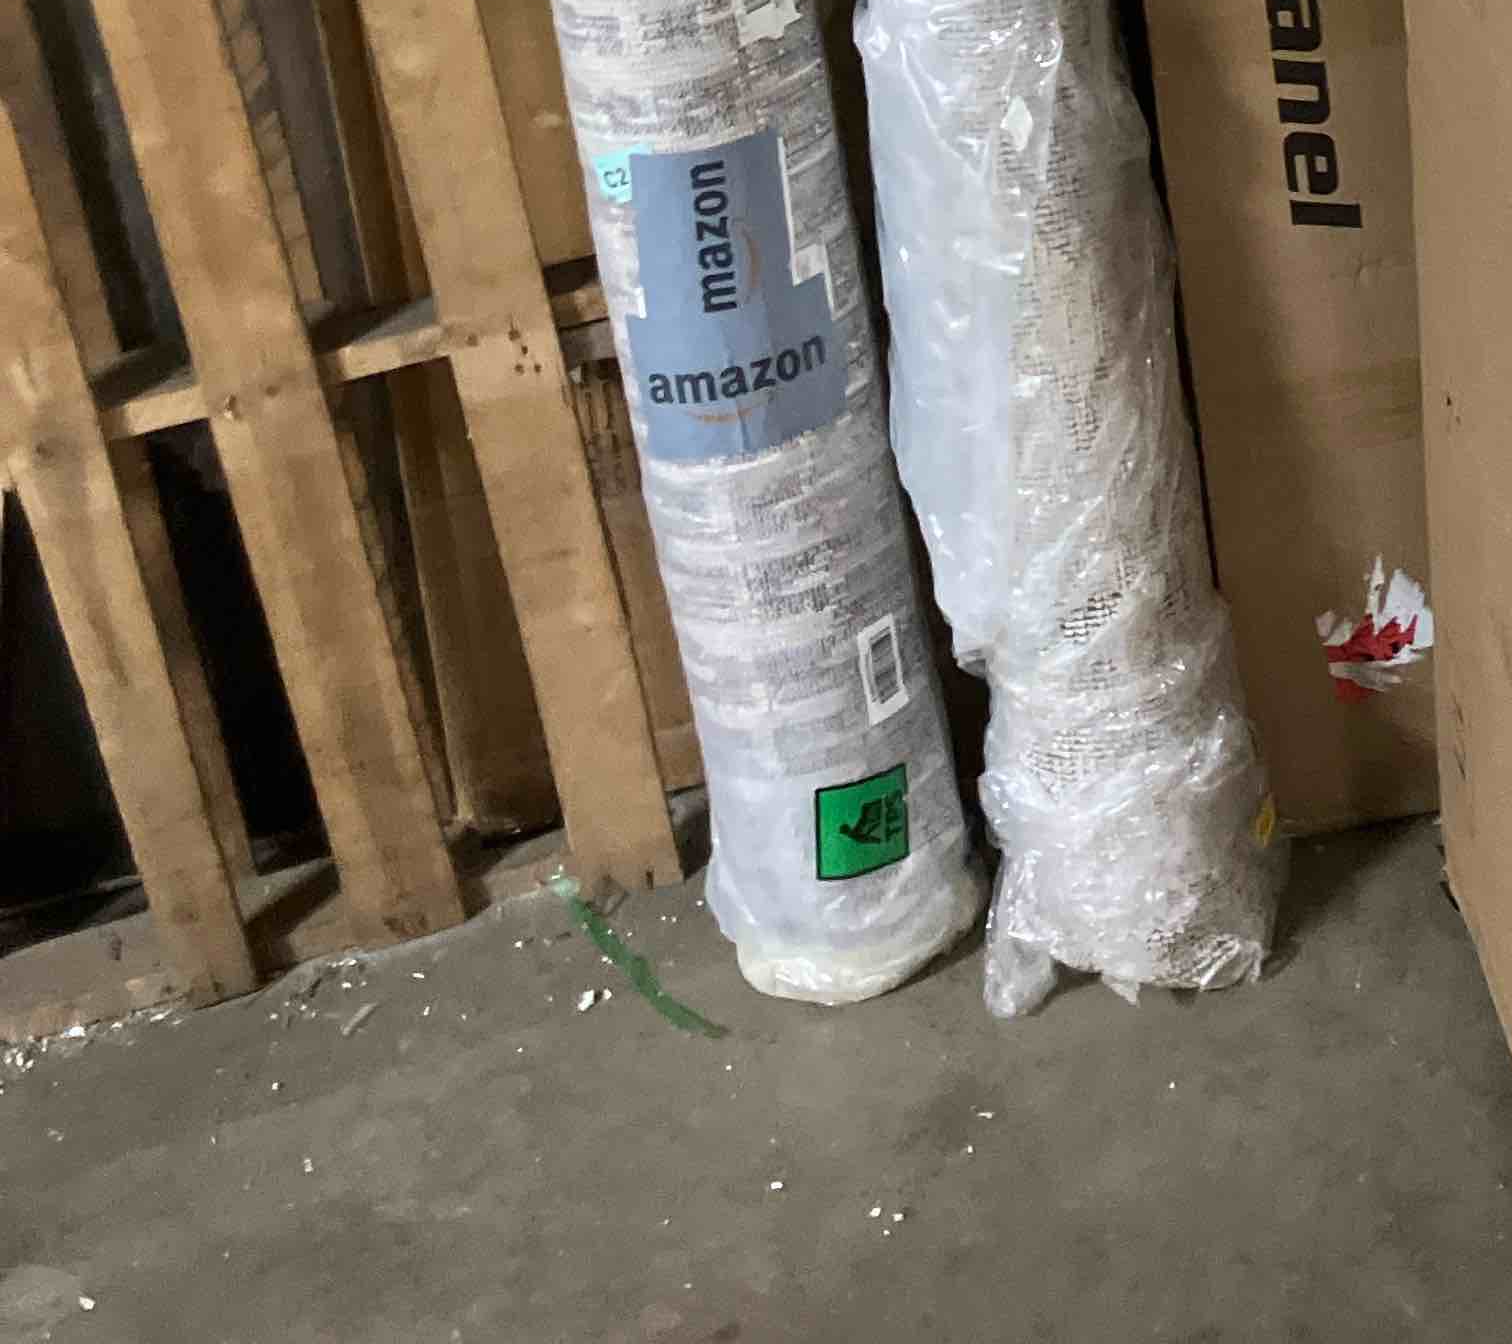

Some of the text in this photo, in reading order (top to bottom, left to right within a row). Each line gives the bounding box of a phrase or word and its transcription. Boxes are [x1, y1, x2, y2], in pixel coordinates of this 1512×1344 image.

[603, 167, 629, 191] C2
[689, 159, 738, 315] mazon
[648, 334, 828, 406] amazon
